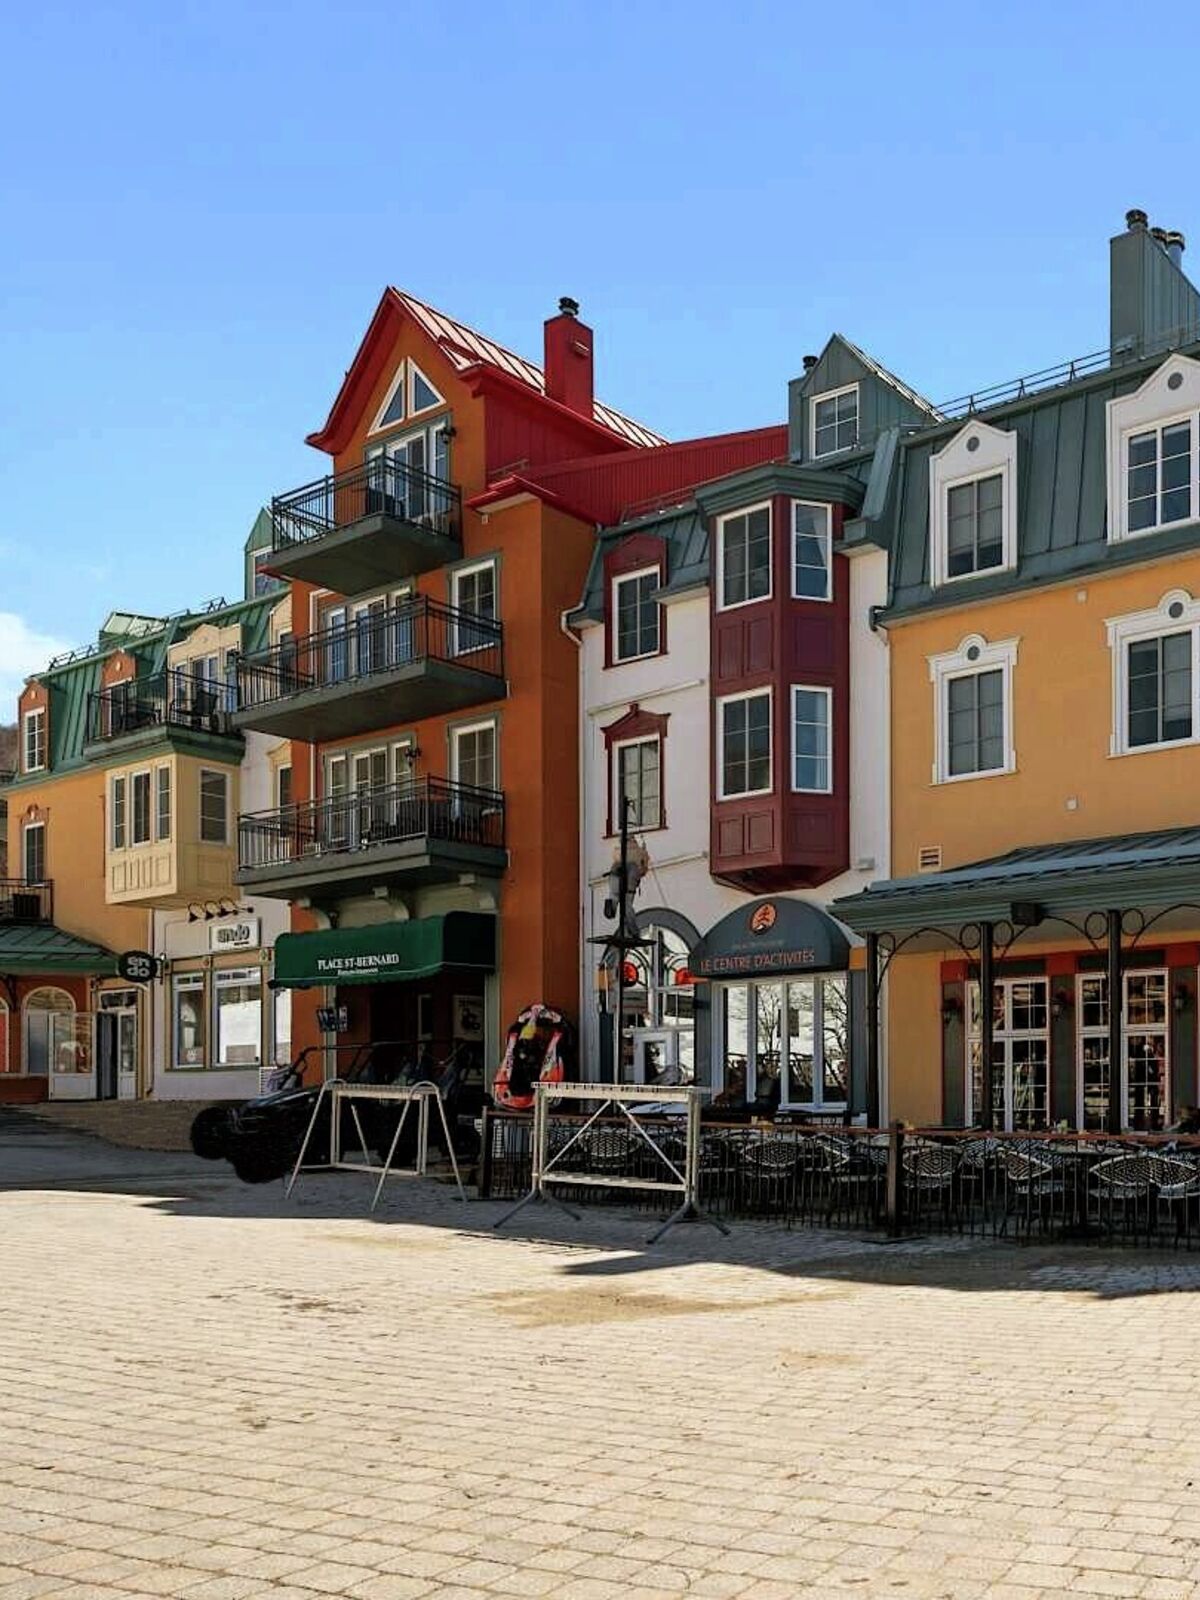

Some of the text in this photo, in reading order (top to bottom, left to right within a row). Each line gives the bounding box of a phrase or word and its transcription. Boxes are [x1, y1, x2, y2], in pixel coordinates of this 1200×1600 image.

[127, 955, 150, 966] en
[317, 953, 400, 971] PLACE ST-BERNARD
[700, 959, 711, 972] LE
[713, 955, 750, 972] CENTRE
[126, 965, 150, 977] do
